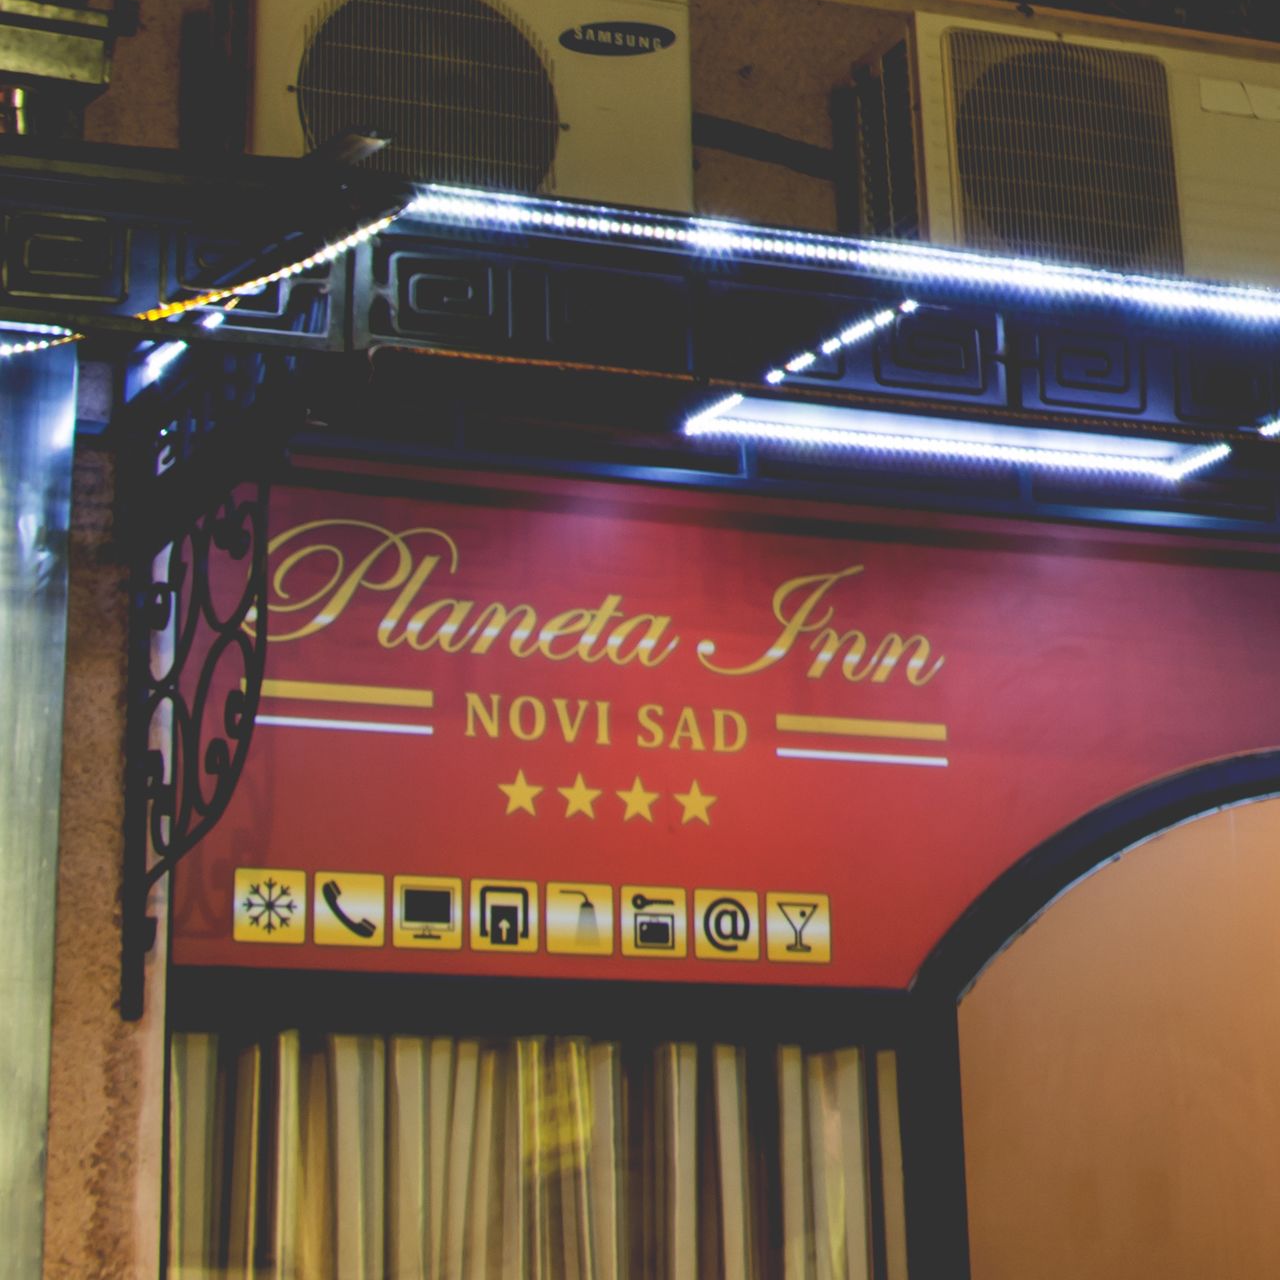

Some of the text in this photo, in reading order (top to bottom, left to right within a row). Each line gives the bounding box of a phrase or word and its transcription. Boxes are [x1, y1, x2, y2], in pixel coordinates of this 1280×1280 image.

[573, 25, 663, 50] SAMSUNG
[241, 518, 945, 686] Planeta Inn
[463, 691, 749, 754] NOVI SAD
